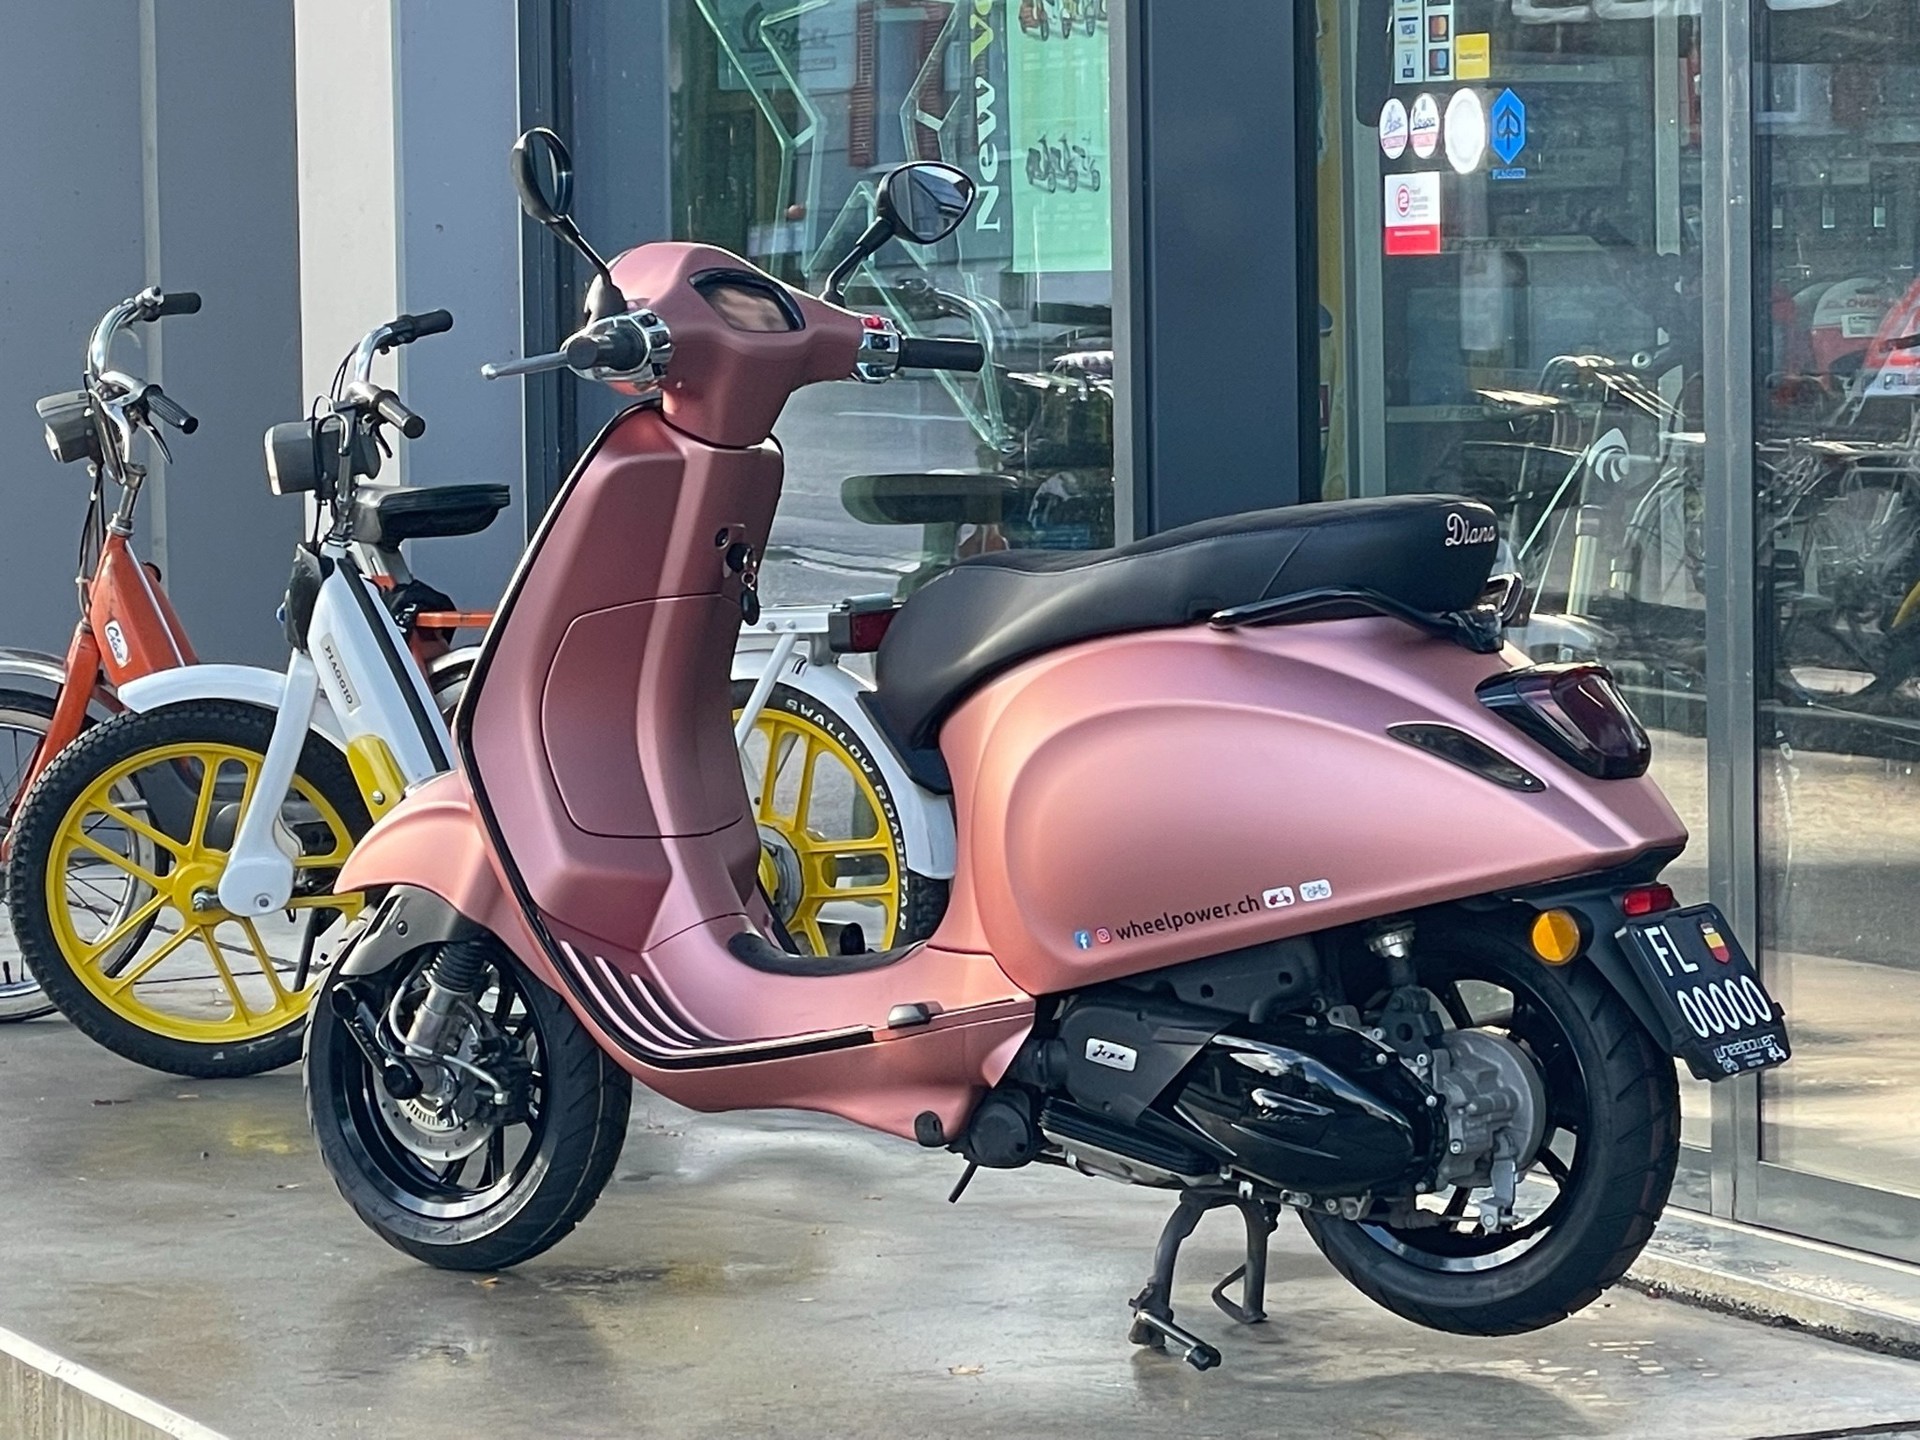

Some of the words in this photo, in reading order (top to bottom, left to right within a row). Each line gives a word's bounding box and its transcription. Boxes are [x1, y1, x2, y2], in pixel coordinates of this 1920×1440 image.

[974, 76, 1000, 232] New
[325, 645, 354, 705] PIAGGIO
[785, 698, 874, 773] SWALLOW
[1116, 895, 1261, 941] wheelpower.ch
[1644, 925, 1700, 977] FL
[1677, 974, 1773, 1039] 00000
